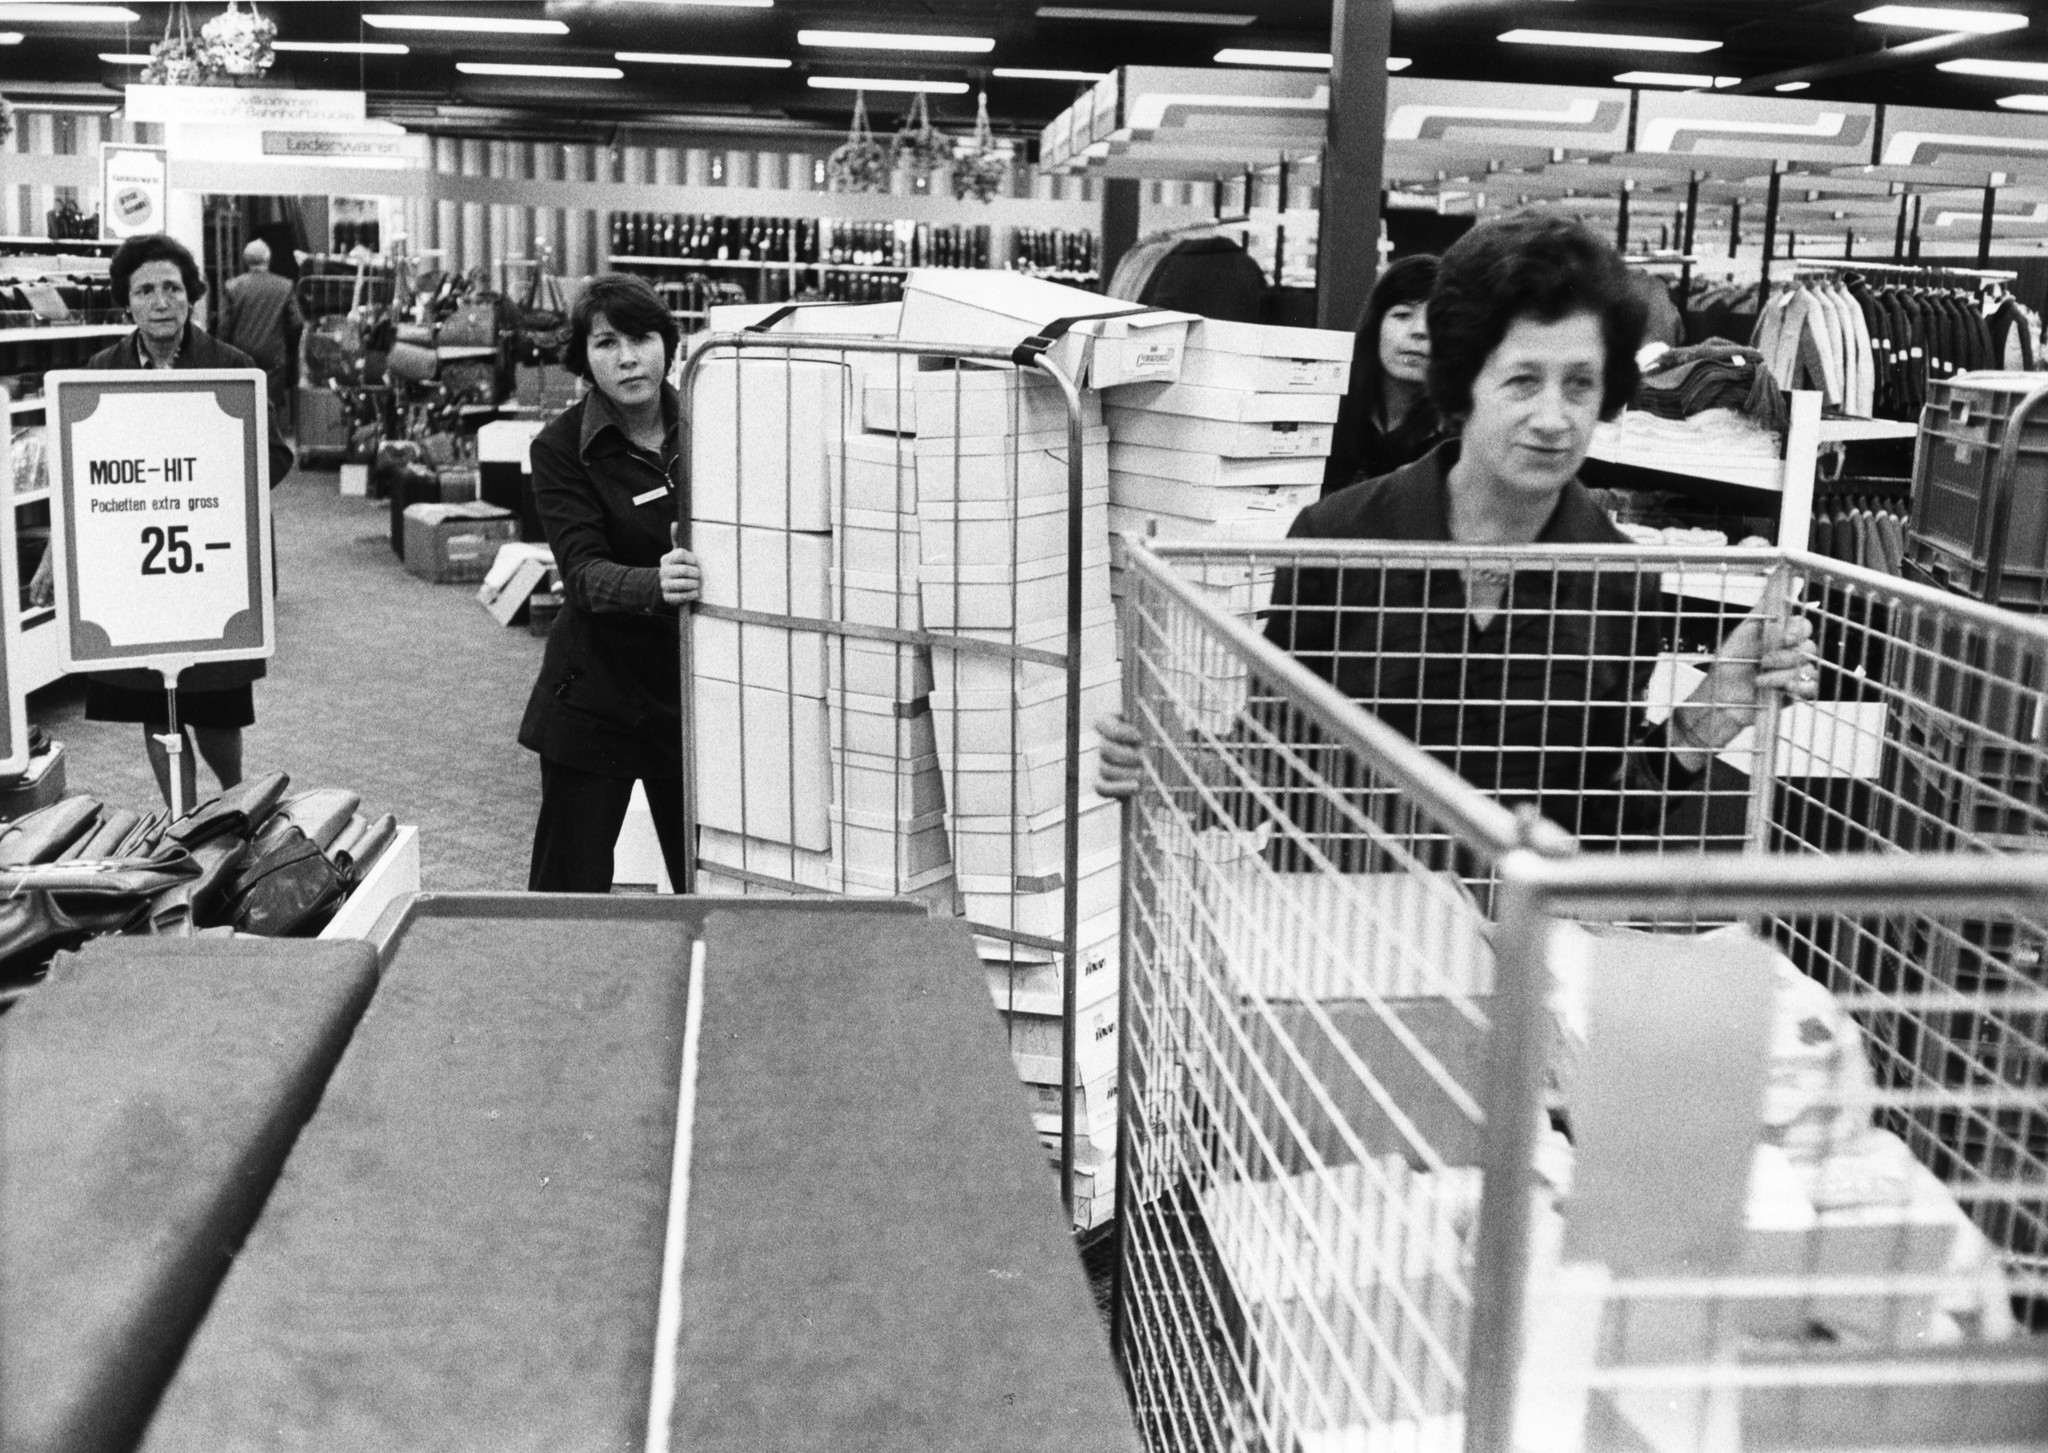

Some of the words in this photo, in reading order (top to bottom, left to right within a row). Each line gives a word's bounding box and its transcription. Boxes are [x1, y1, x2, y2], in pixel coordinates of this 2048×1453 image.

[286, 136, 400, 153] Lederwaren
[89, 457, 197, 485] MODE-HIT
[90, 497, 146, 513] Pochetten
[152, 496, 181, 510] extra
[188, 497, 220, 511] gross
